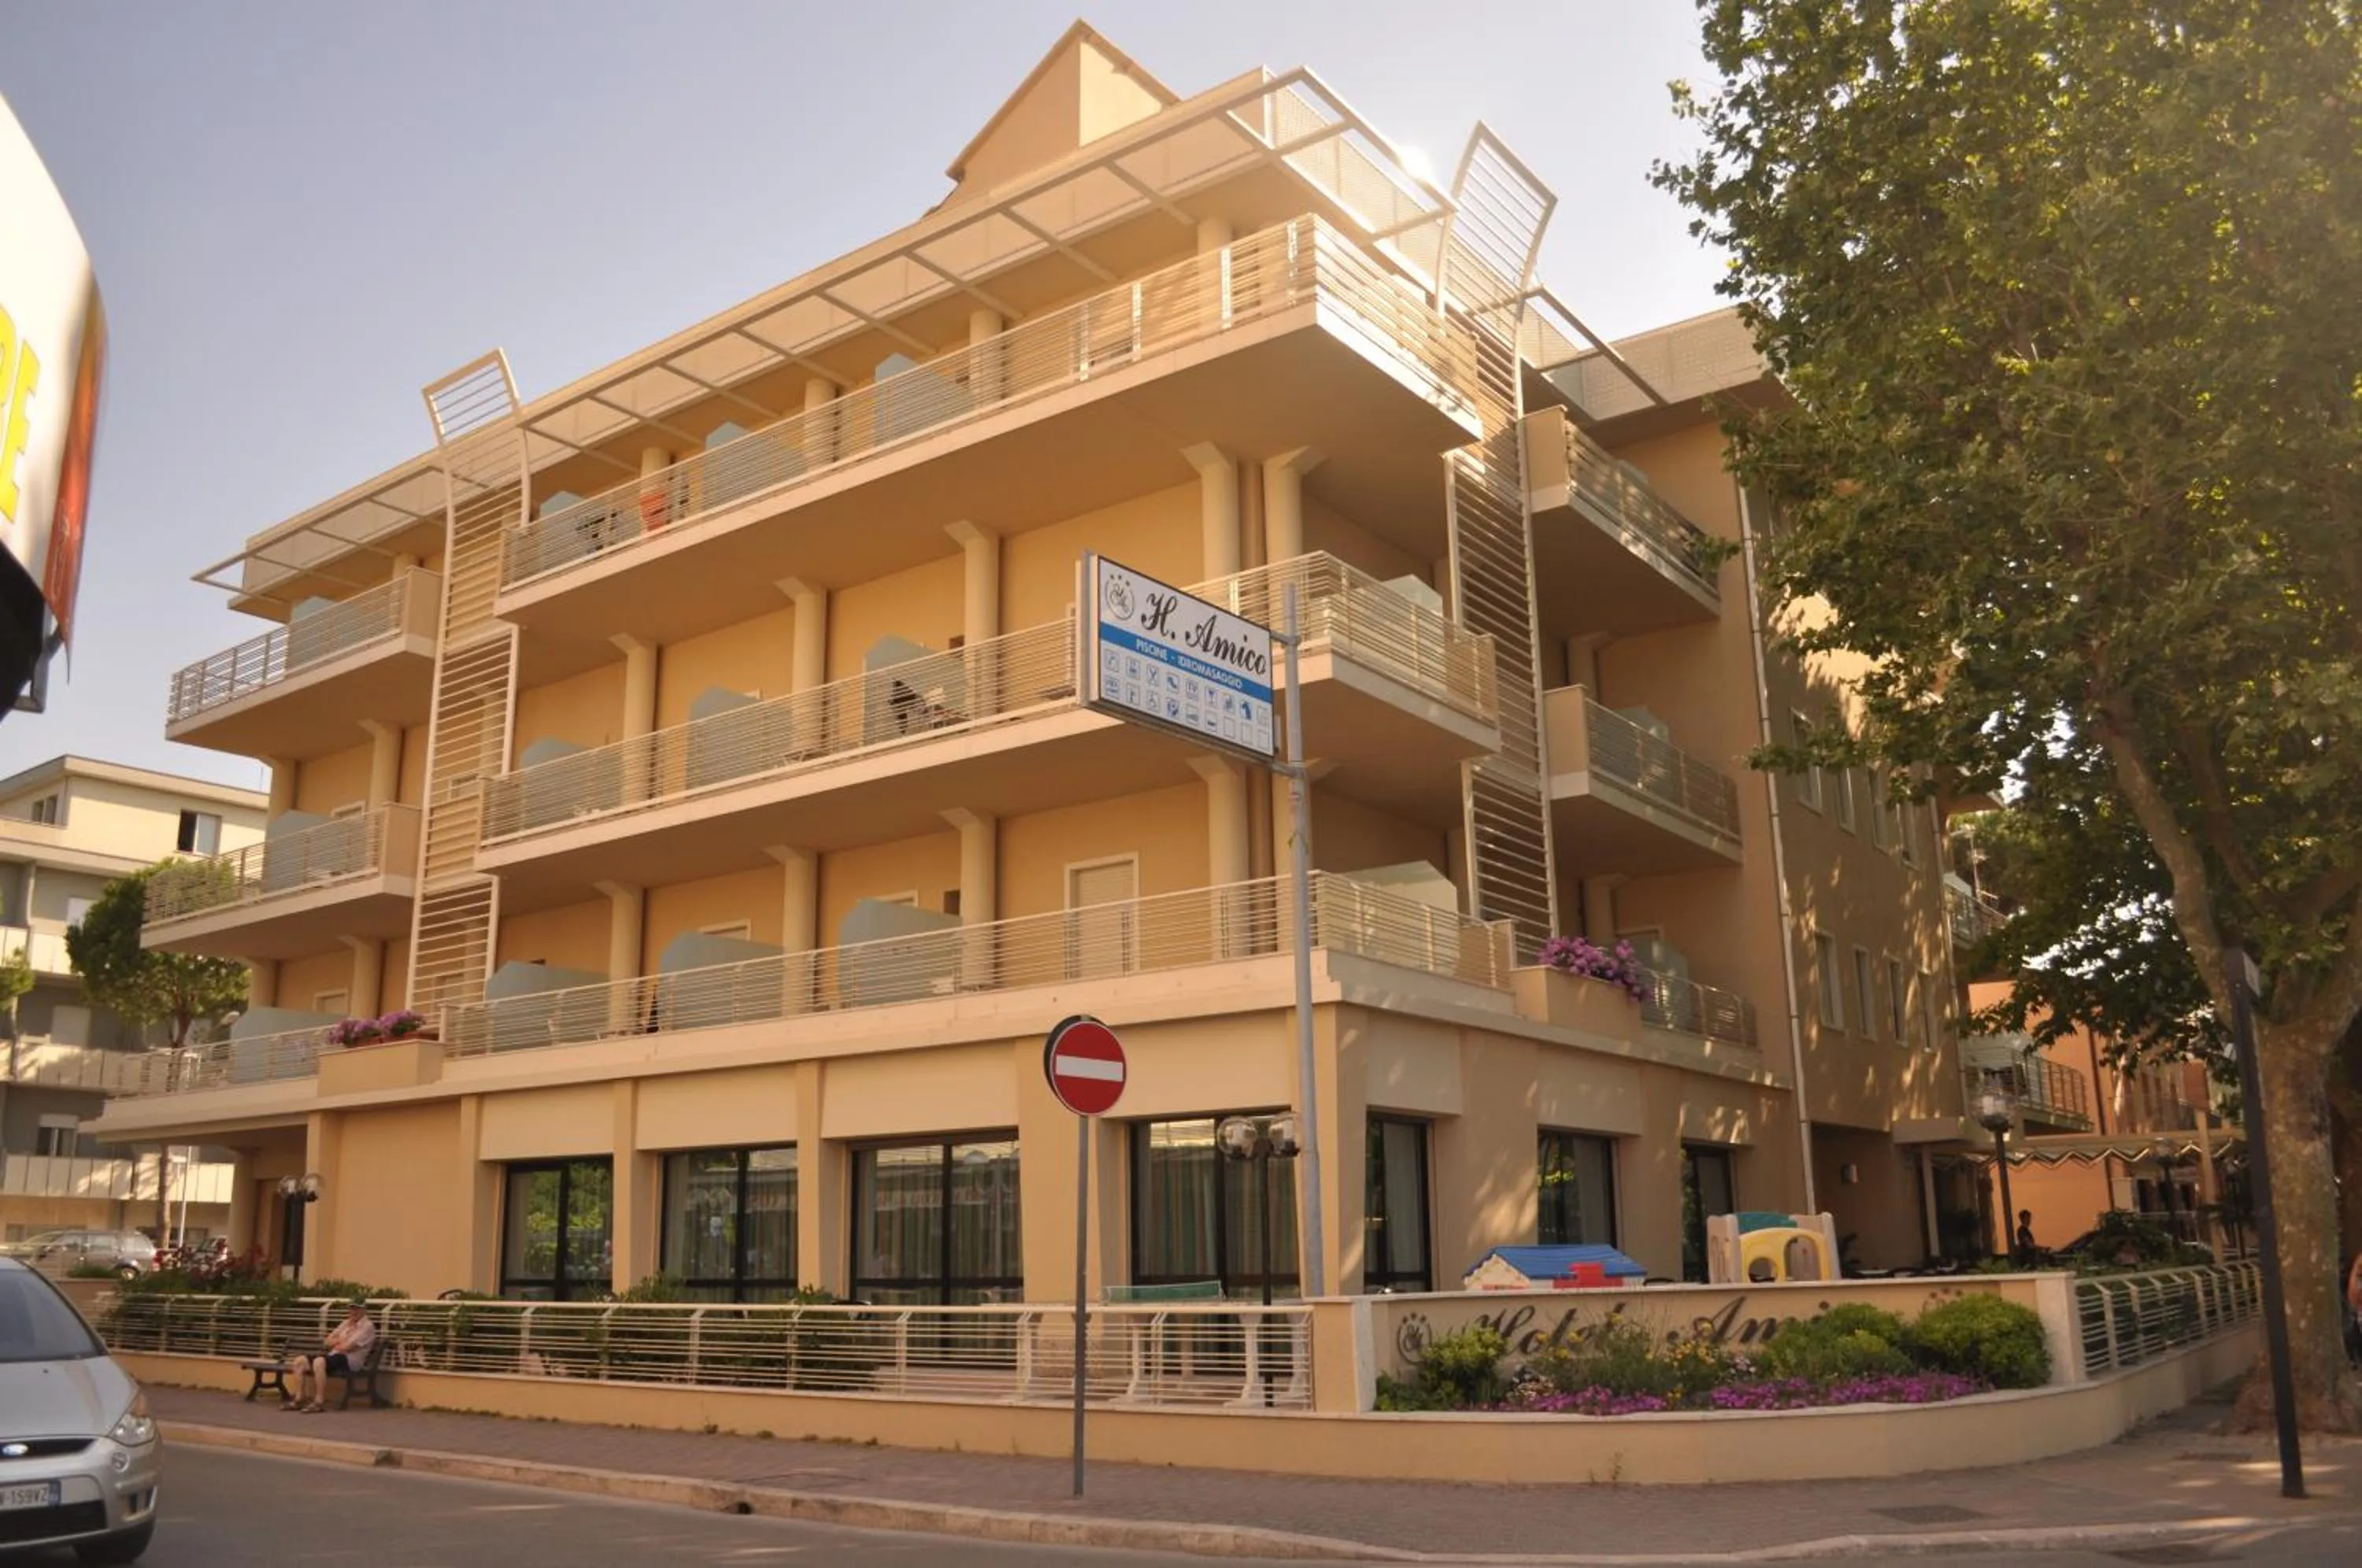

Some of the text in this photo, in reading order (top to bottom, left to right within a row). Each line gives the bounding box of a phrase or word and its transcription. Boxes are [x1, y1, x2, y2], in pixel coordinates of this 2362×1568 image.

[1136, 638, 1168, 662] PISCINE
[1141, 593, 1267, 675] H. Amico
